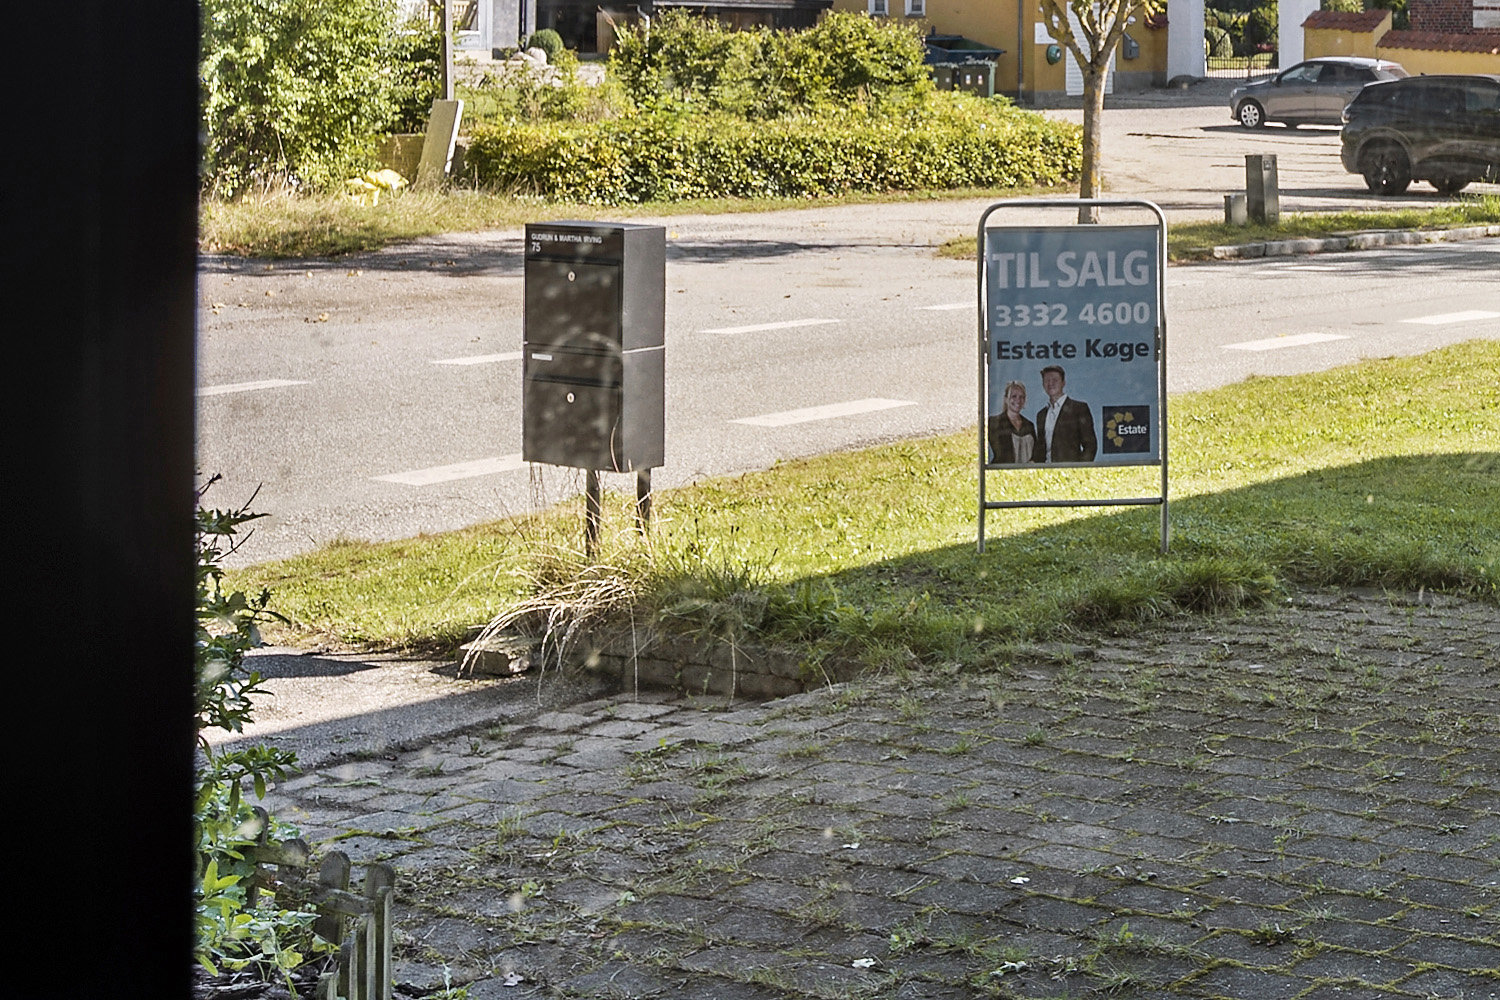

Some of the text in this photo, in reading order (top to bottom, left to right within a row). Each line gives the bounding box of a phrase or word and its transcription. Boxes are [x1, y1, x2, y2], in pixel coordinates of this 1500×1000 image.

[531, 241, 541, 252] 75
[992, 250, 1149, 289] TIL SALG
[995, 301, 1150, 327] 3332 4600
[996, 338, 1150, 362] Estate Køge
[1118, 424, 1147, 435] Estate
